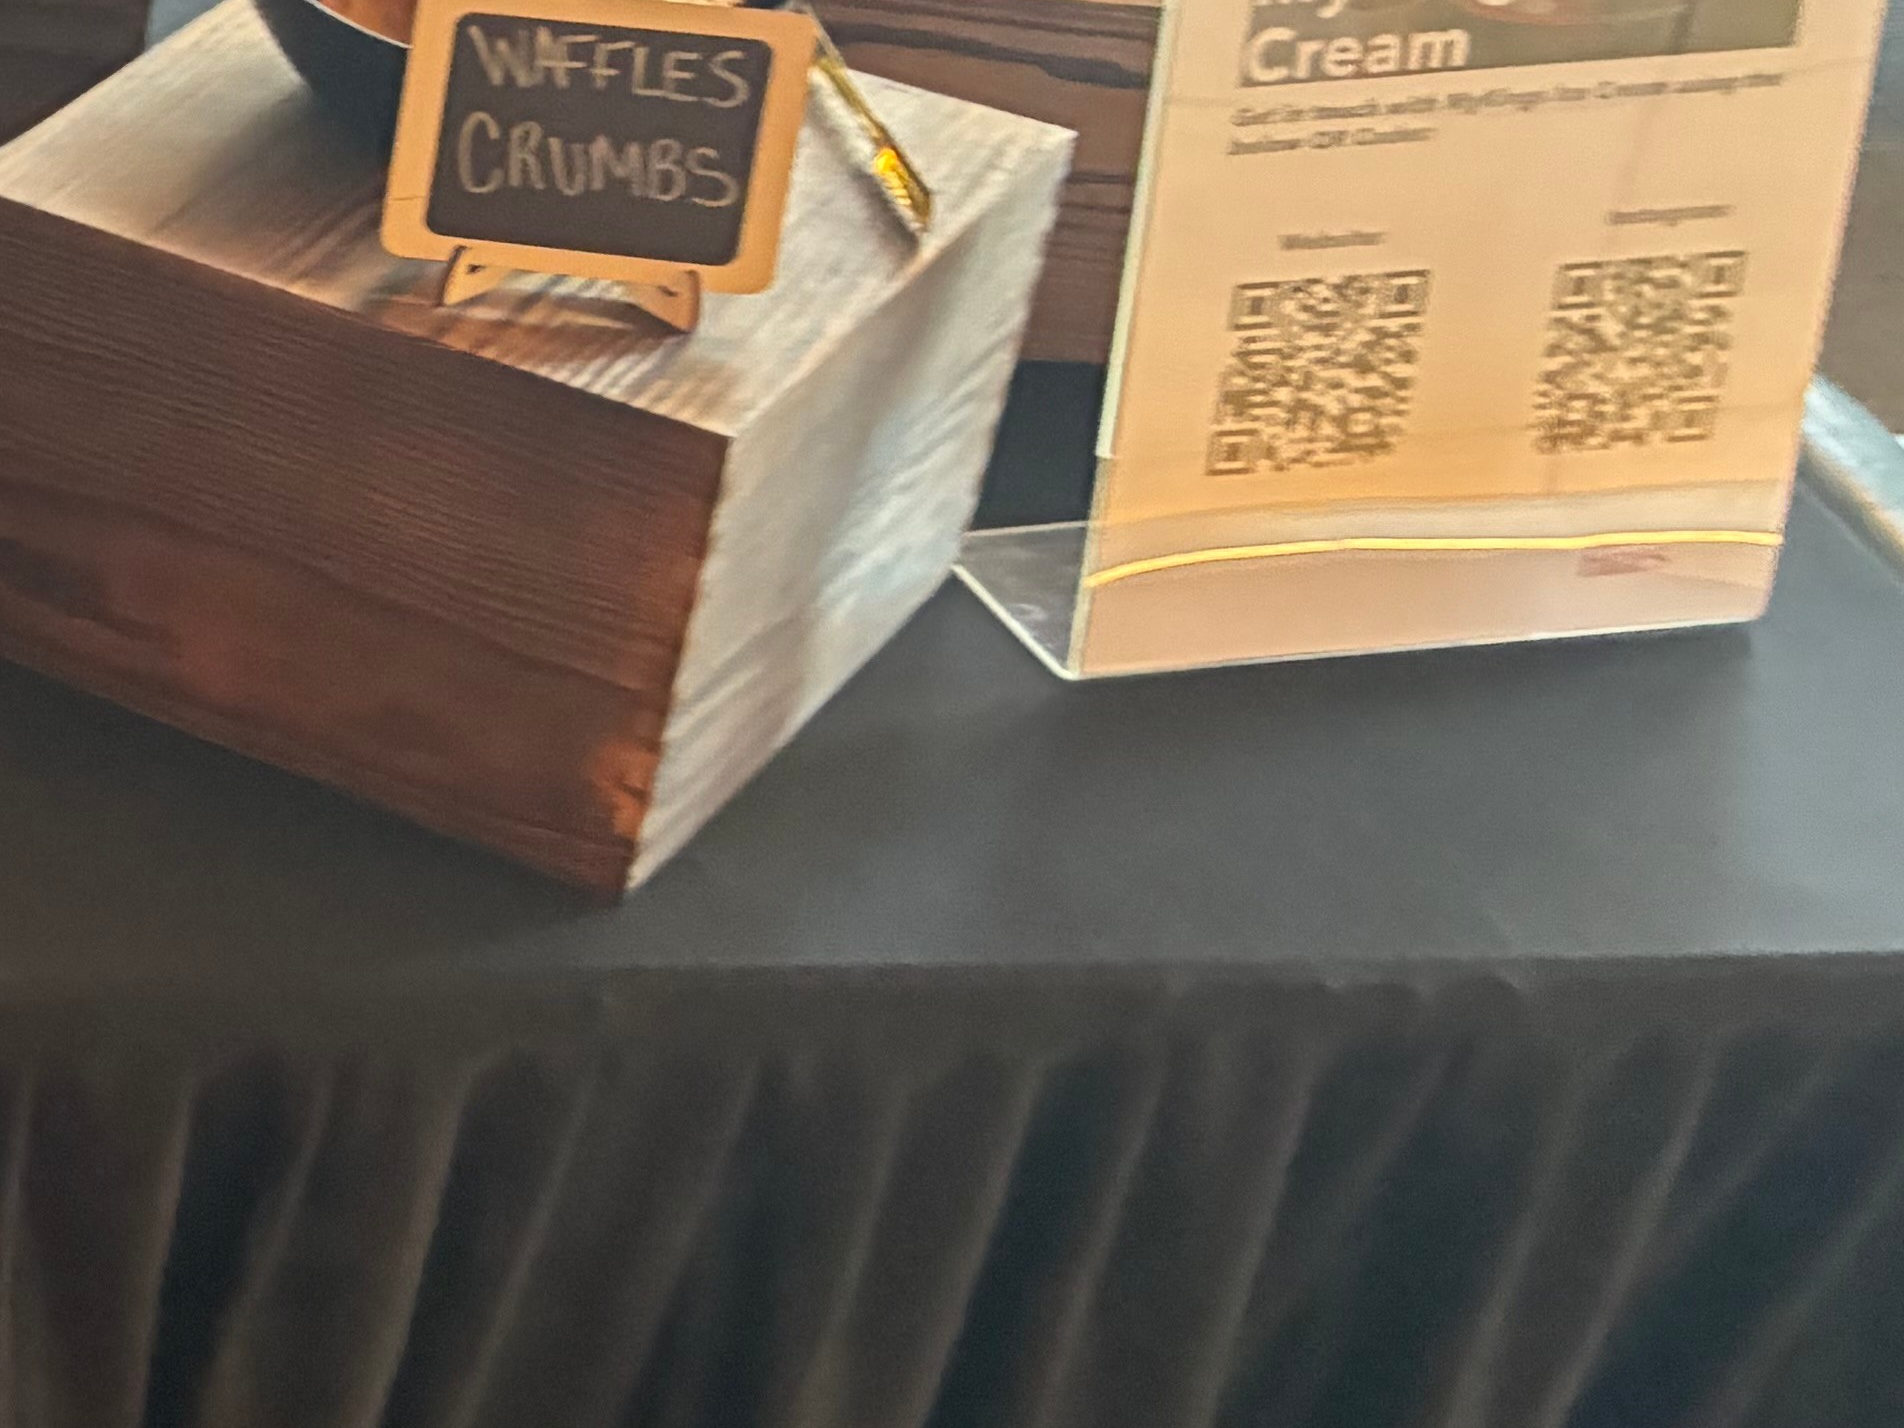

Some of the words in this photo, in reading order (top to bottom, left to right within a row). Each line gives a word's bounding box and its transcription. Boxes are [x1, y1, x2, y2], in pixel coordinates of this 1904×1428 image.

[466, 24, 750, 108] WAFFLES
[1245, 26, 1472, 83] Cream
[457, 110, 740, 208] CRUMBS
